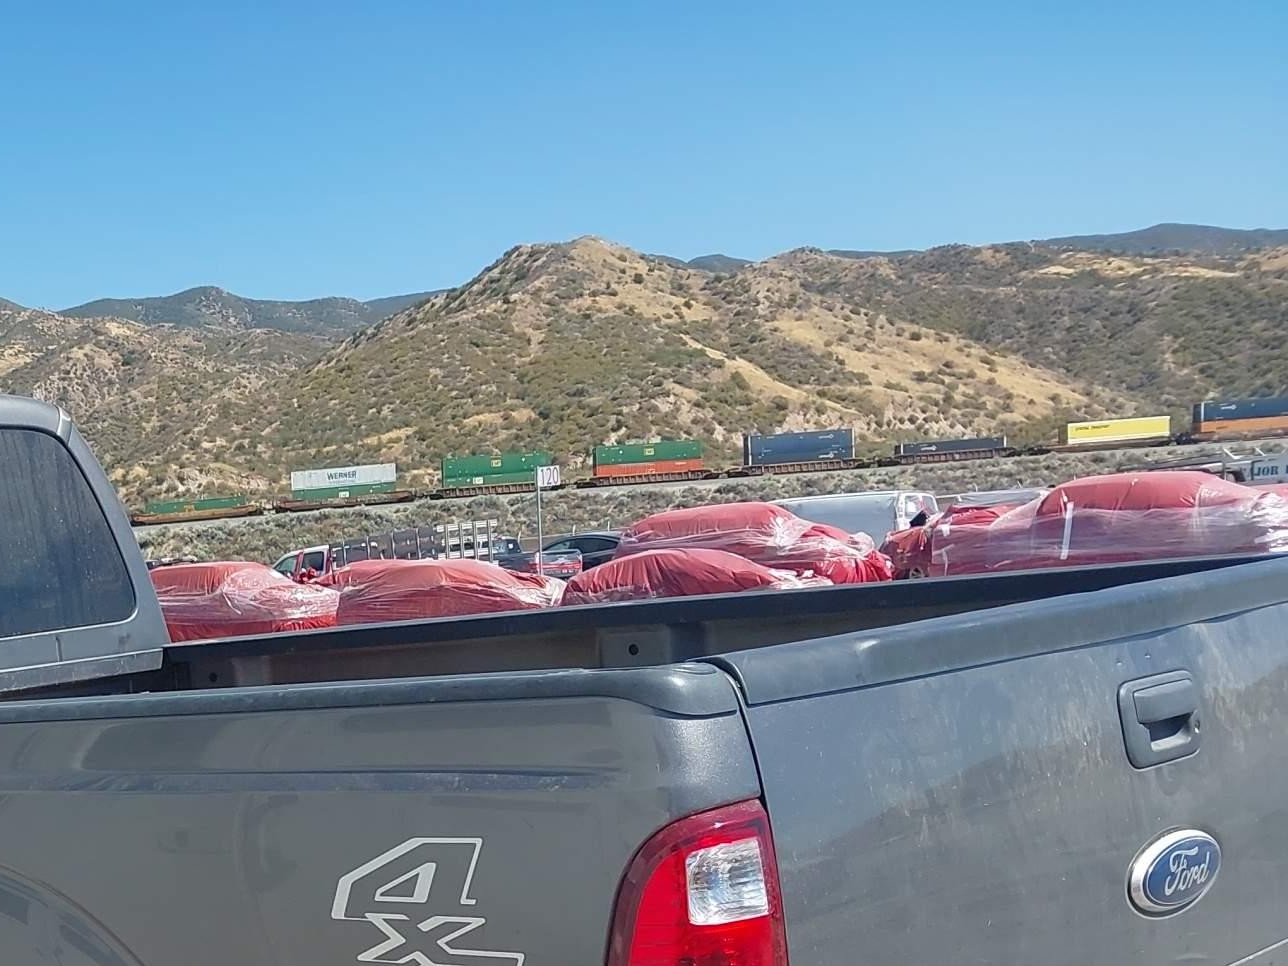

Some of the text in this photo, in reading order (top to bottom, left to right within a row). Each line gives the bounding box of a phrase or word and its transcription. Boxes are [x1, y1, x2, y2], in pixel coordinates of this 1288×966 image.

[327, 470, 357, 481] WERNER
[540, 467, 560, 485] 120
[1162, 844, 1214, 897] Ford
